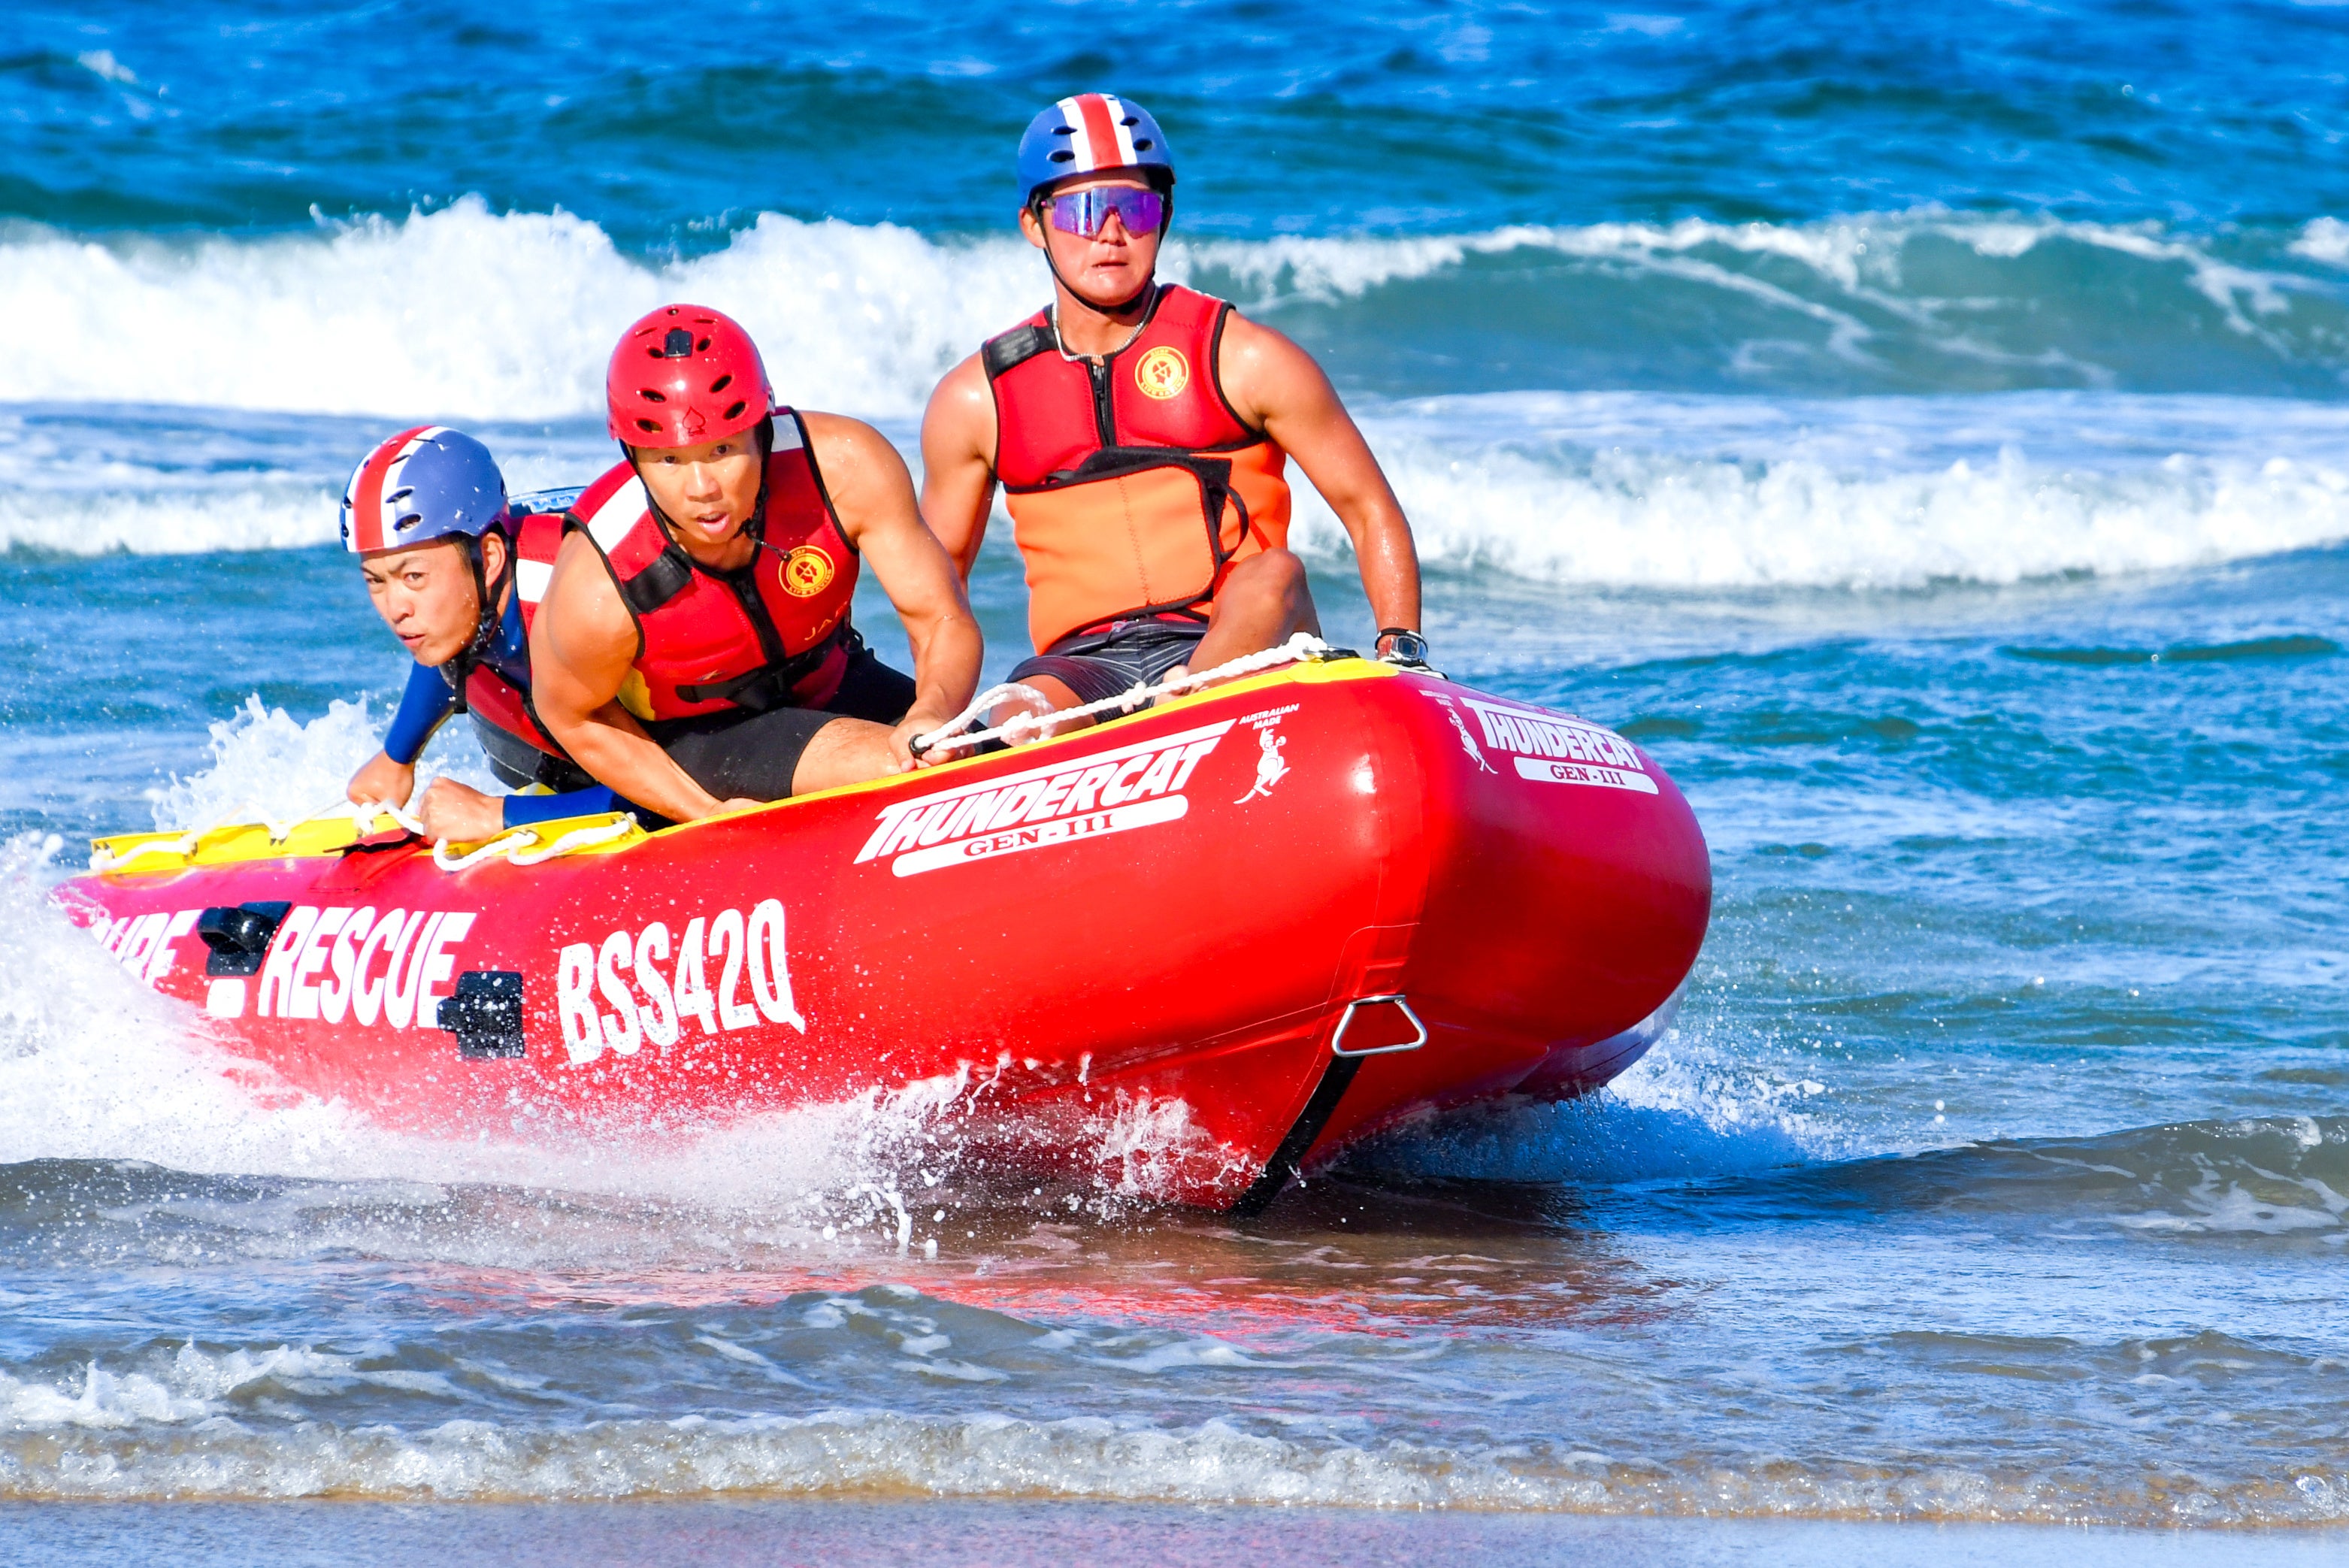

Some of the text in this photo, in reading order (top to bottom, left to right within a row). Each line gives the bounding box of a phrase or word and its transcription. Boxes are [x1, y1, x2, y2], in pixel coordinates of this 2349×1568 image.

[1238, 703, 1300, 725] AUSTRALIAN
[1252, 715, 1282, 730] MADE
[1460, 696, 1645, 771] THUNDERCAT
[852, 718, 1238, 864] THUNDERCAT
[257, 905, 477, 1029] RESCUE
[557, 898, 806, 1066] BSS42Q
